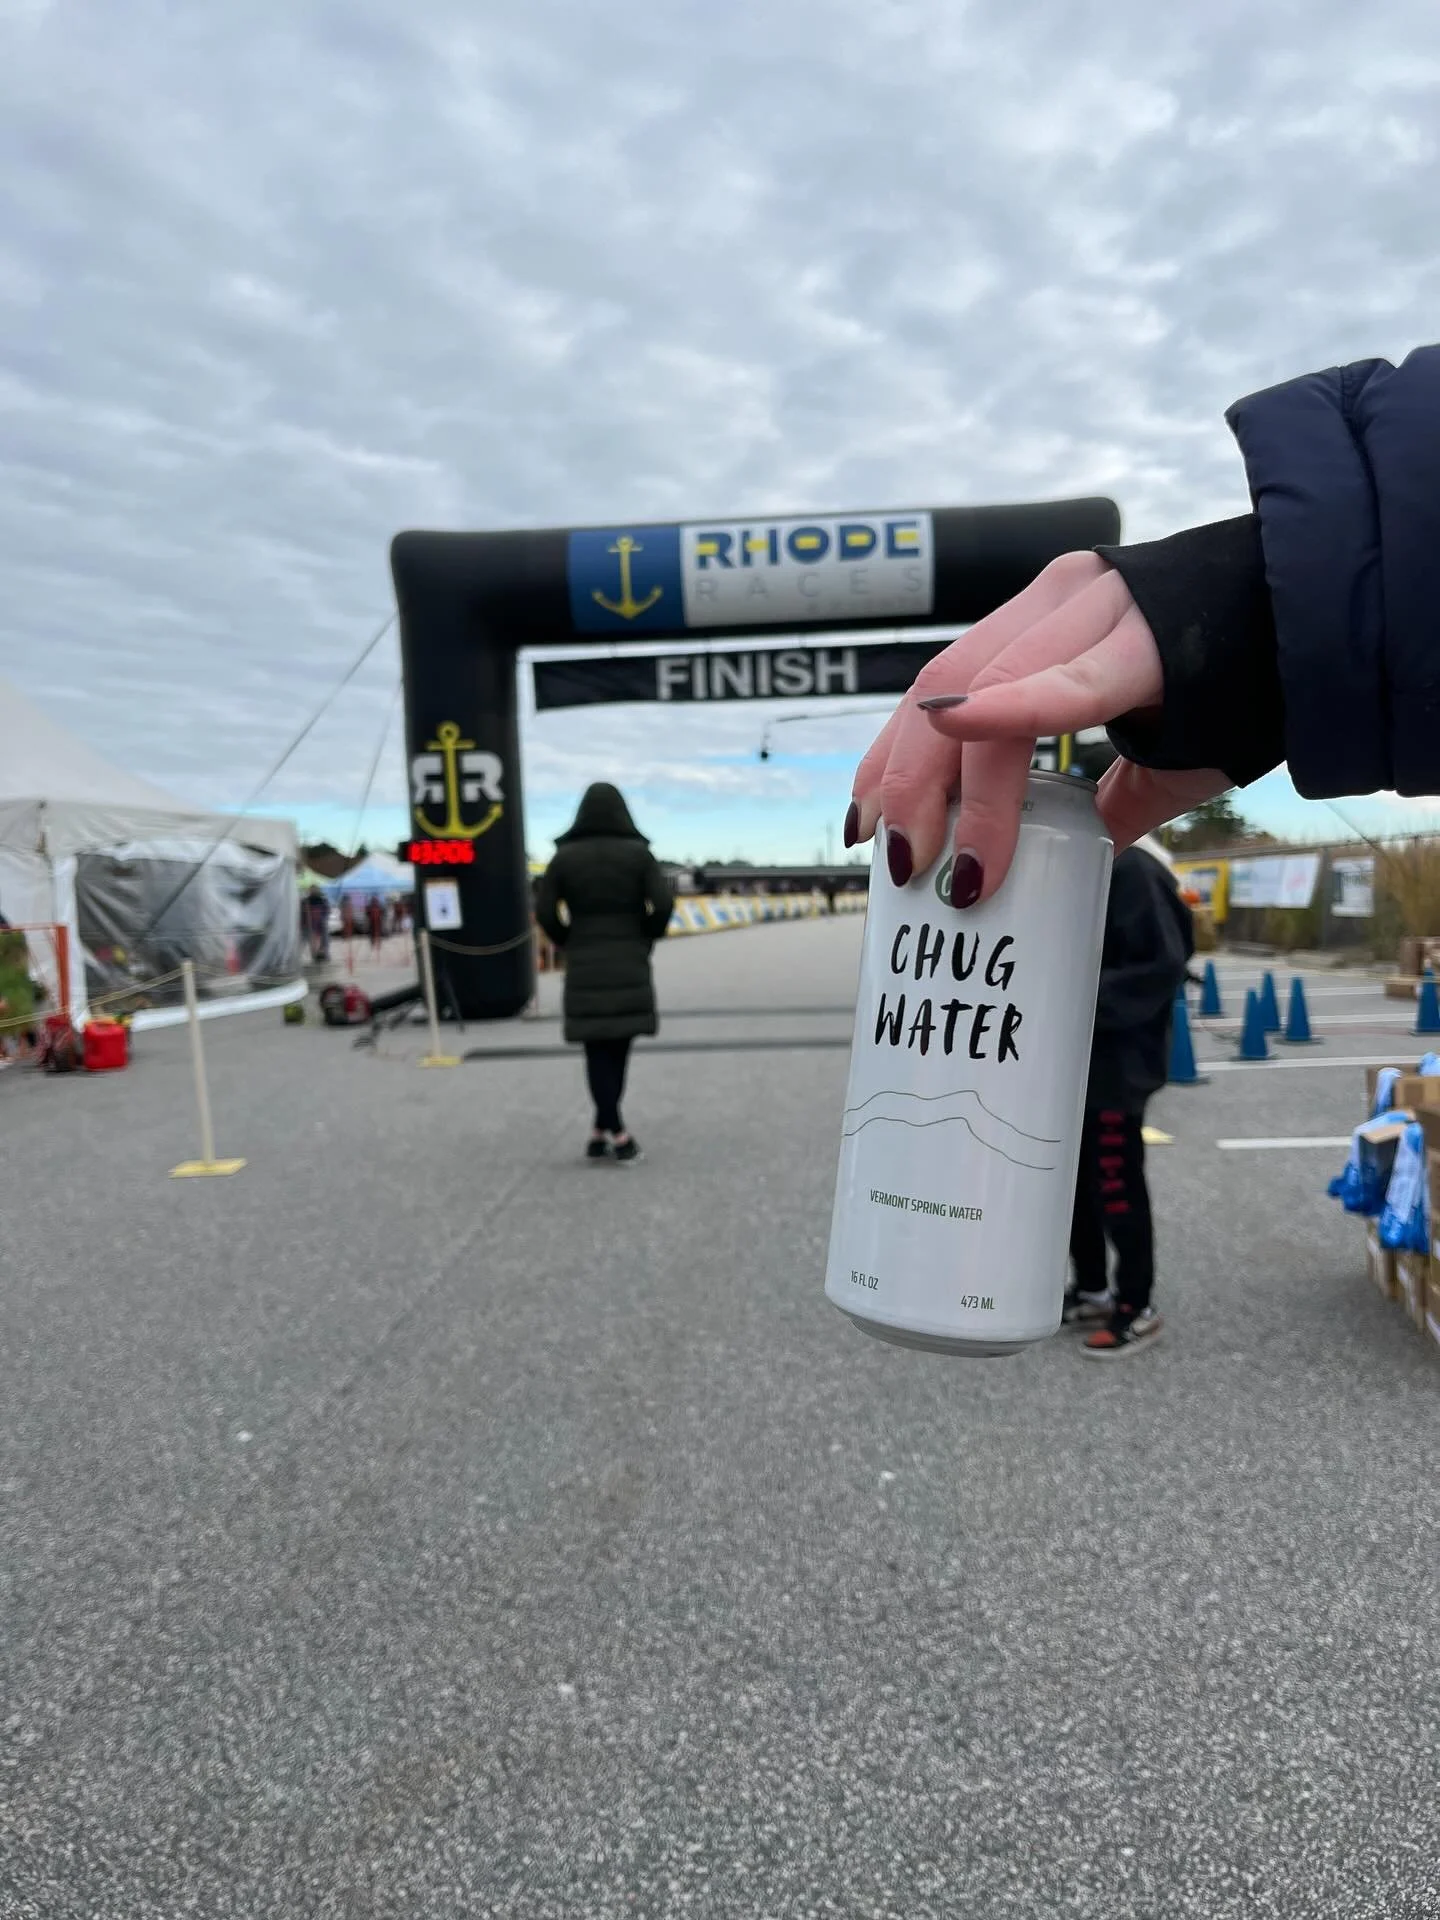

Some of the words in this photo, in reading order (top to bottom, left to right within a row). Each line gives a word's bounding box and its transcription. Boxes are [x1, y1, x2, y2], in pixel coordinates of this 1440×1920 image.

[695, 520, 922, 570] RHODE
[694, 566, 923, 601] RACES
[656, 648, 859, 700] FINISH
[891, 923, 1017, 991] CHUG
[874, 992, 1023, 1064] WATER
[870, 1189, 909, 1210] VERMONT
[911, 1199, 947, 1217] SPRING
[949, 1205, 983, 1221] WATER
[851, 1270, 858, 1284] 16
[859, 1274, 867, 1287] FL
[868, 1276, 879, 1290] OZ
[960, 1296, 979, 1309] 473
[980, 1298, 995, 1310] ML
